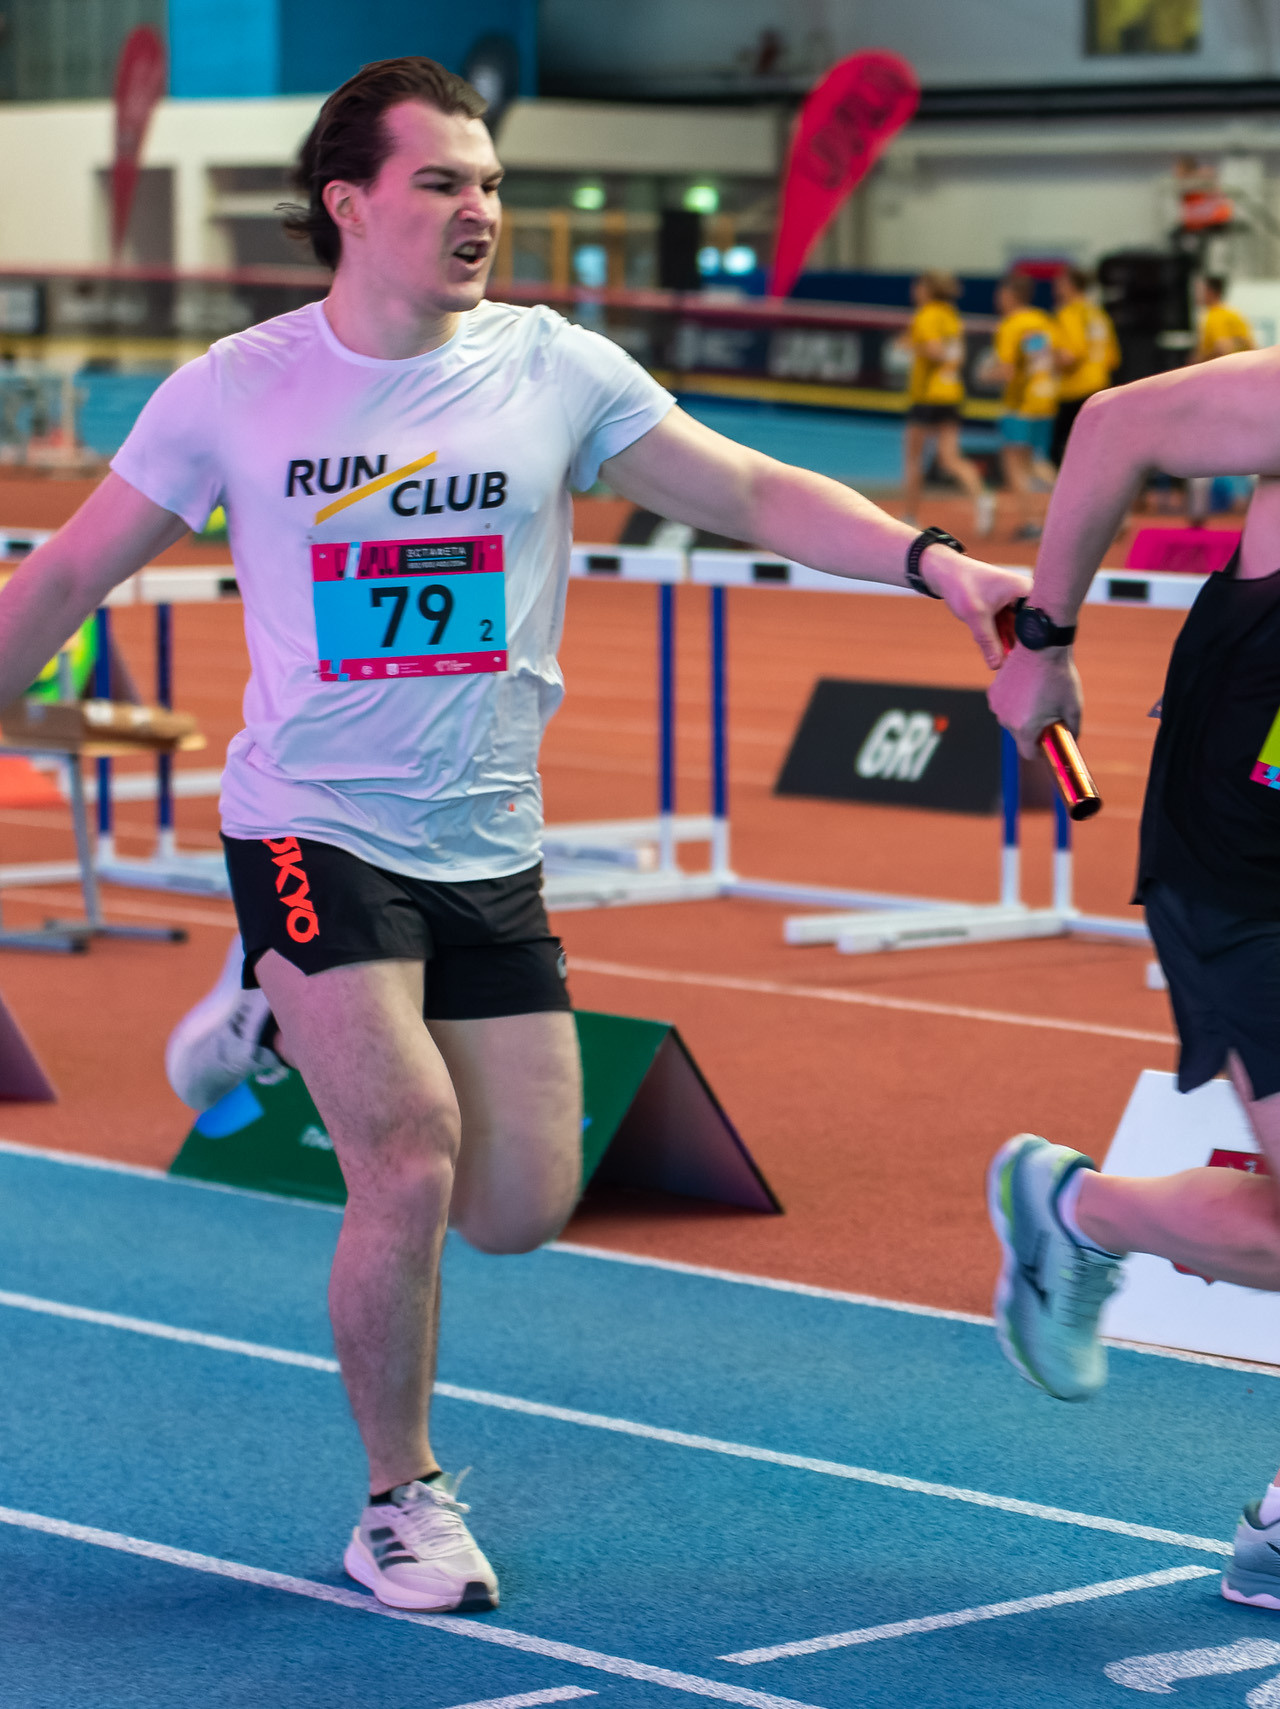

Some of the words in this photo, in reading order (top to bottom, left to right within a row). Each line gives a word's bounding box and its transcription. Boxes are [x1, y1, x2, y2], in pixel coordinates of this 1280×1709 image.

[285, 454, 388, 498] RUN
[389, 470, 508, 517] CLUB
[369, 584, 455, 648] 79
[479, 619, 494, 642] 2
